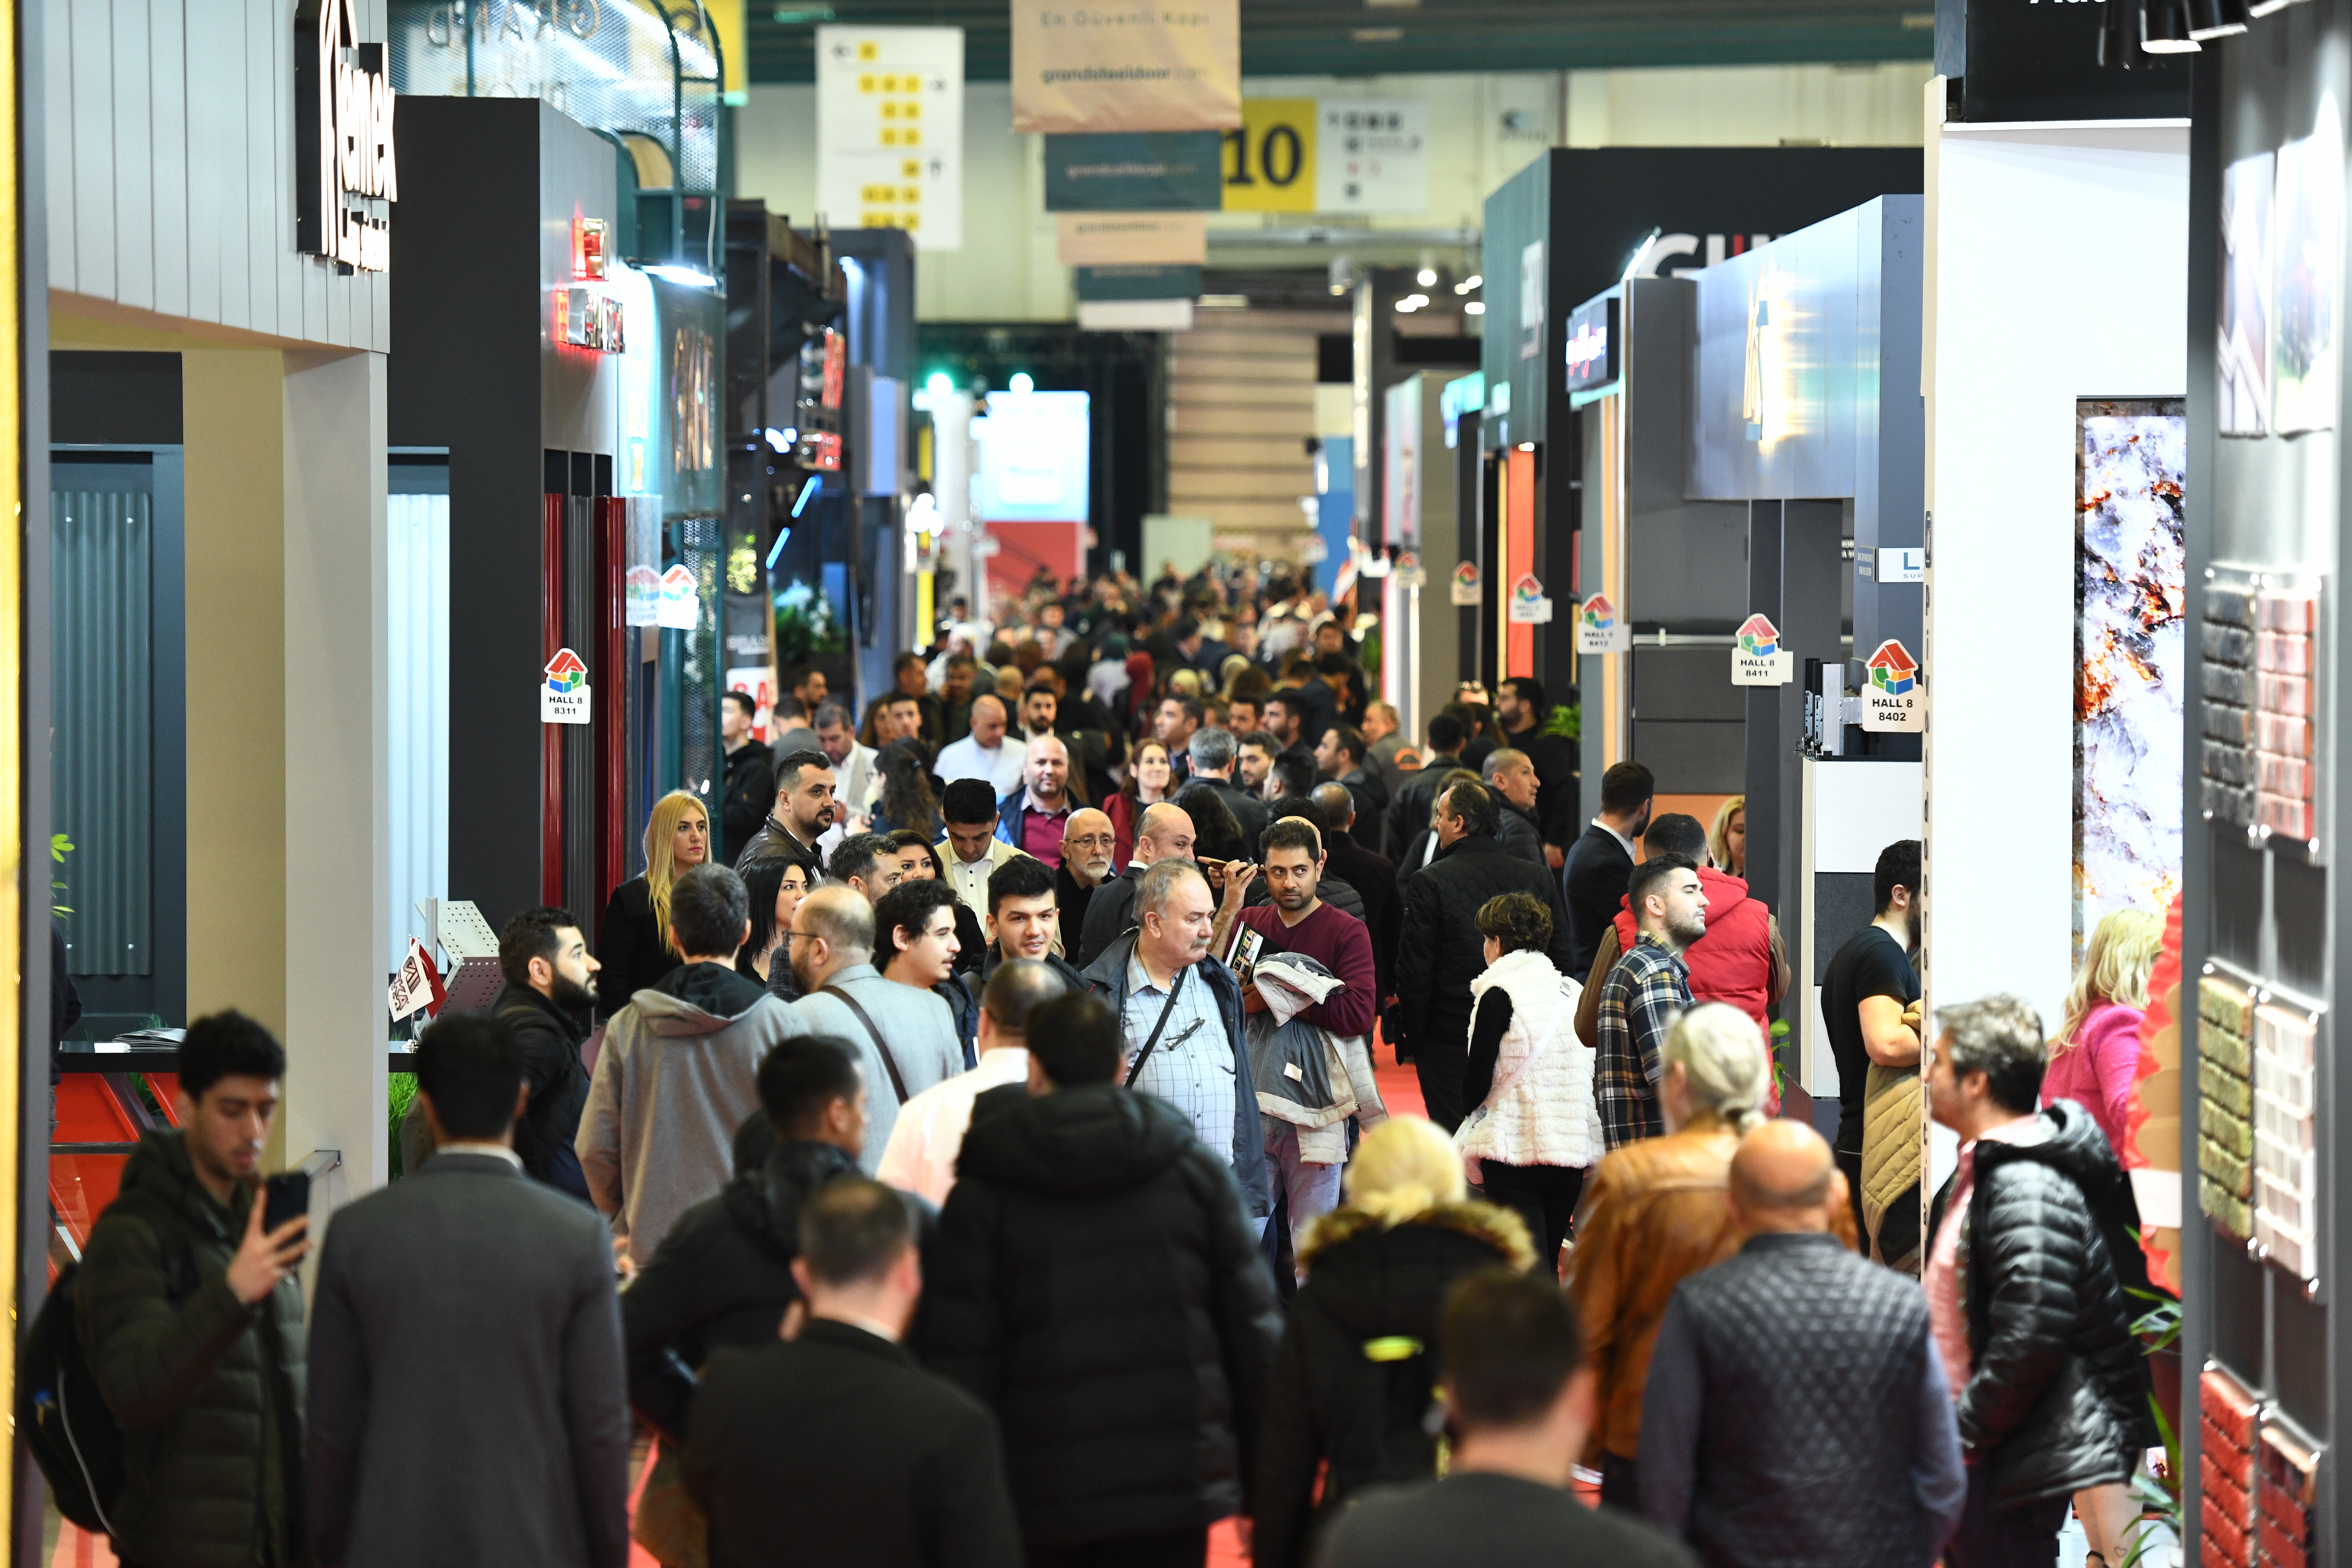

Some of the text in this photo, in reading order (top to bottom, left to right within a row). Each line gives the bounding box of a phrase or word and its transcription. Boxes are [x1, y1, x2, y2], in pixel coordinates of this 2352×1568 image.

[1223, 124, 1303, 187] 10
[1904, 552, 1923, 570] L
[1872, 699, 1913, 708] HALL 8
[1879, 712, 1906, 721] 8402
